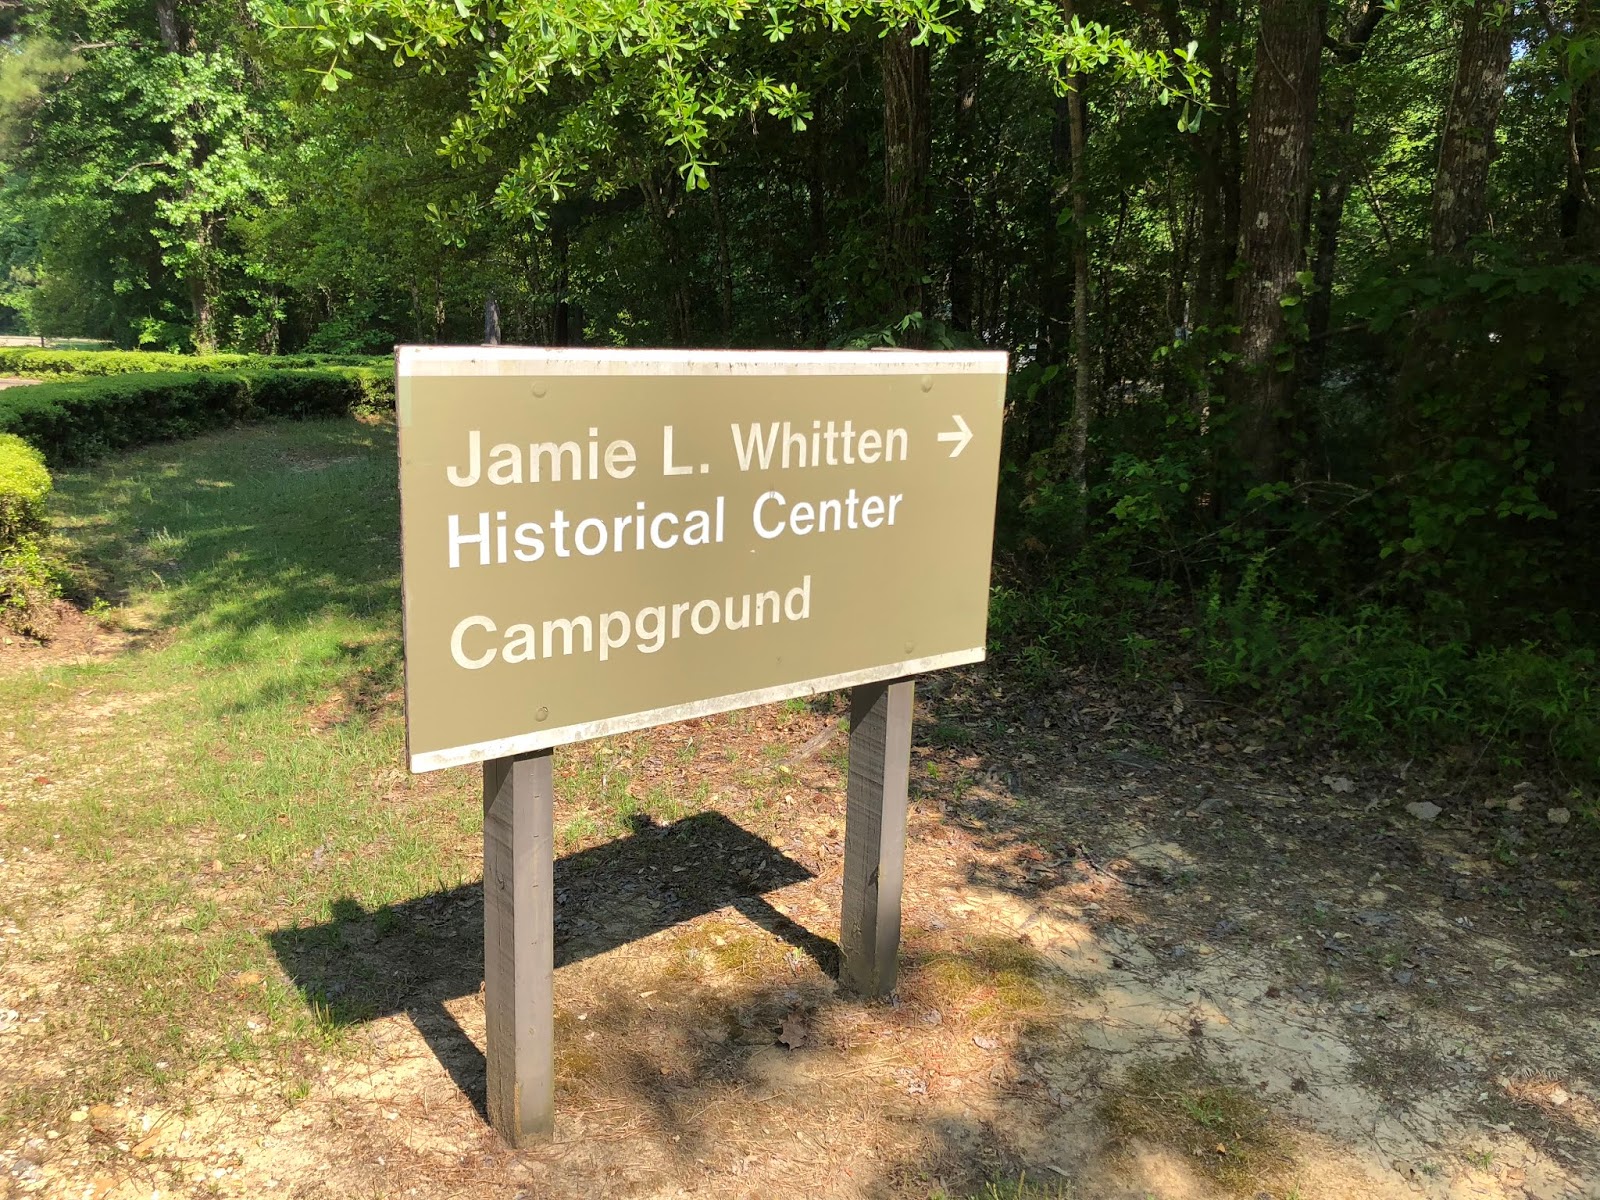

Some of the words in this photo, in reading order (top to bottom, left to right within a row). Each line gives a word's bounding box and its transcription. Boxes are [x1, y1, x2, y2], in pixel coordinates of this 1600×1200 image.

[446, 426, 636, 488] Jamie
[663, 425, 710, 476] L.
[731, 420, 909, 471] Whitten
[447, 496, 725, 570] Historical
[752, 490, 904, 539] Center
[450, 575, 812, 670] Campground
